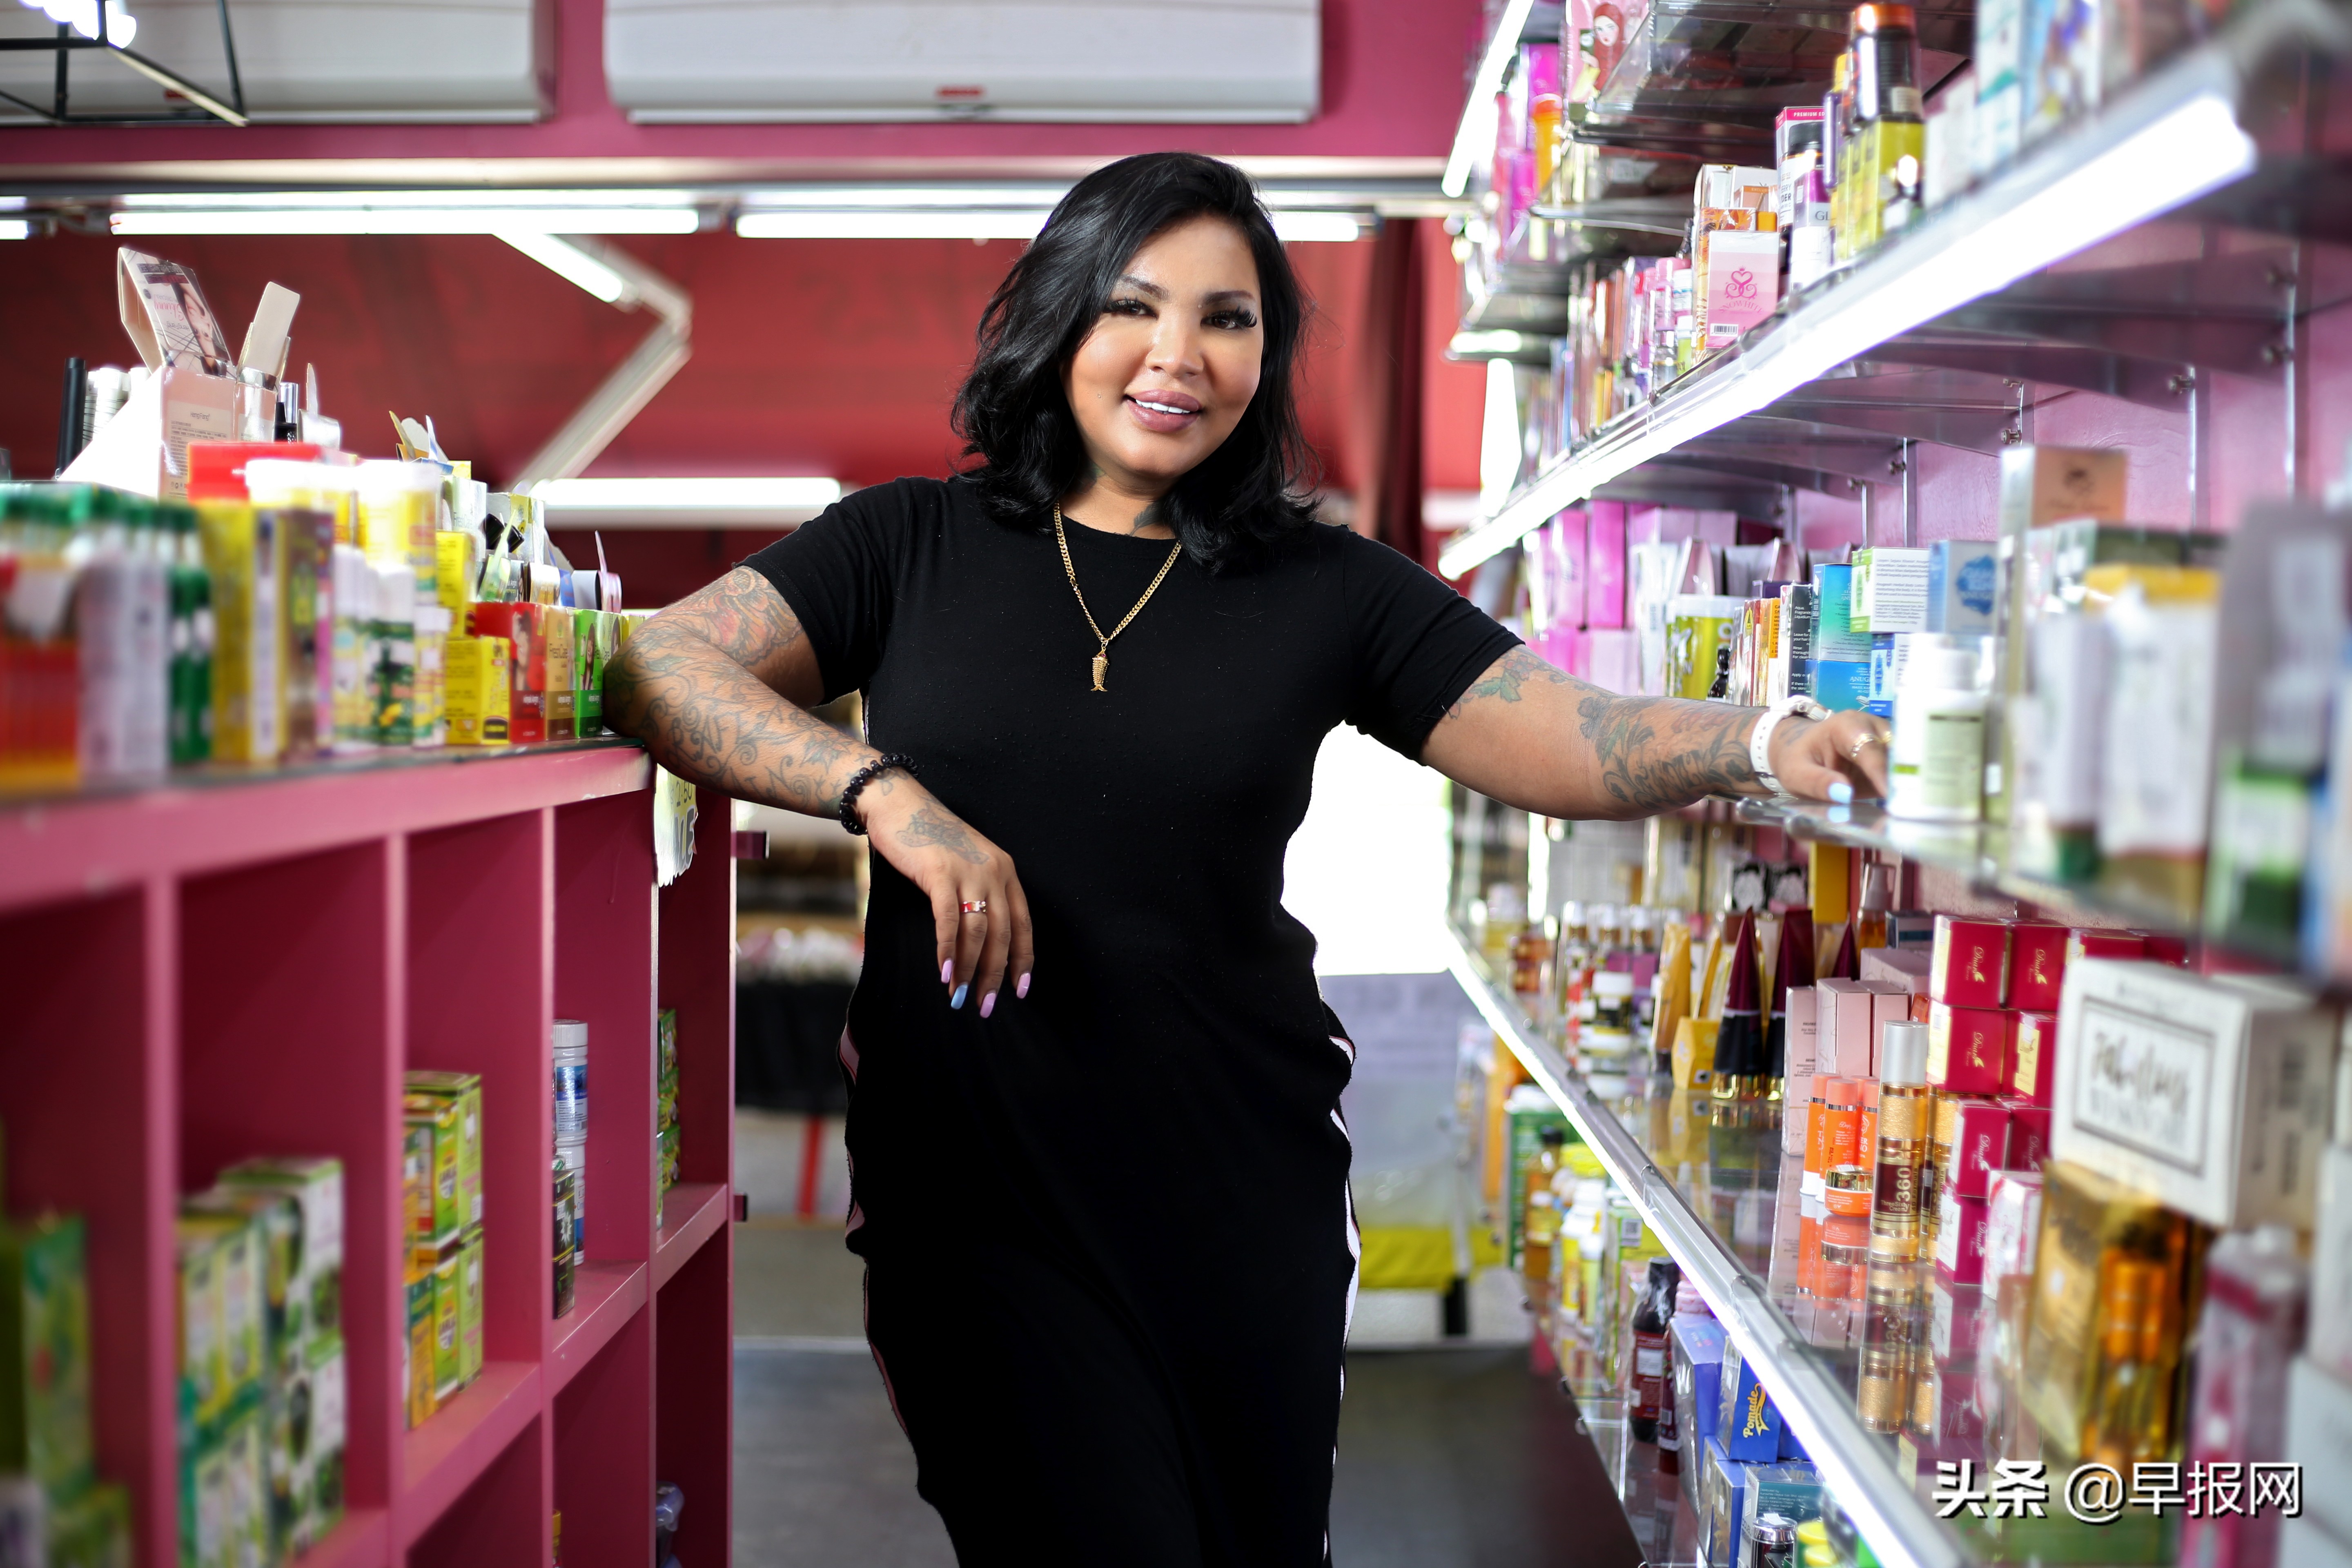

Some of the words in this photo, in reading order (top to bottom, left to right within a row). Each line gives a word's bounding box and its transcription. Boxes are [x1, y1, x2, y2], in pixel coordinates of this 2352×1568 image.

[1781, 193, 1791, 203] DER
[1896, 1167, 1911, 1202] 360
[1742, 1389, 1759, 1438] Pomade
